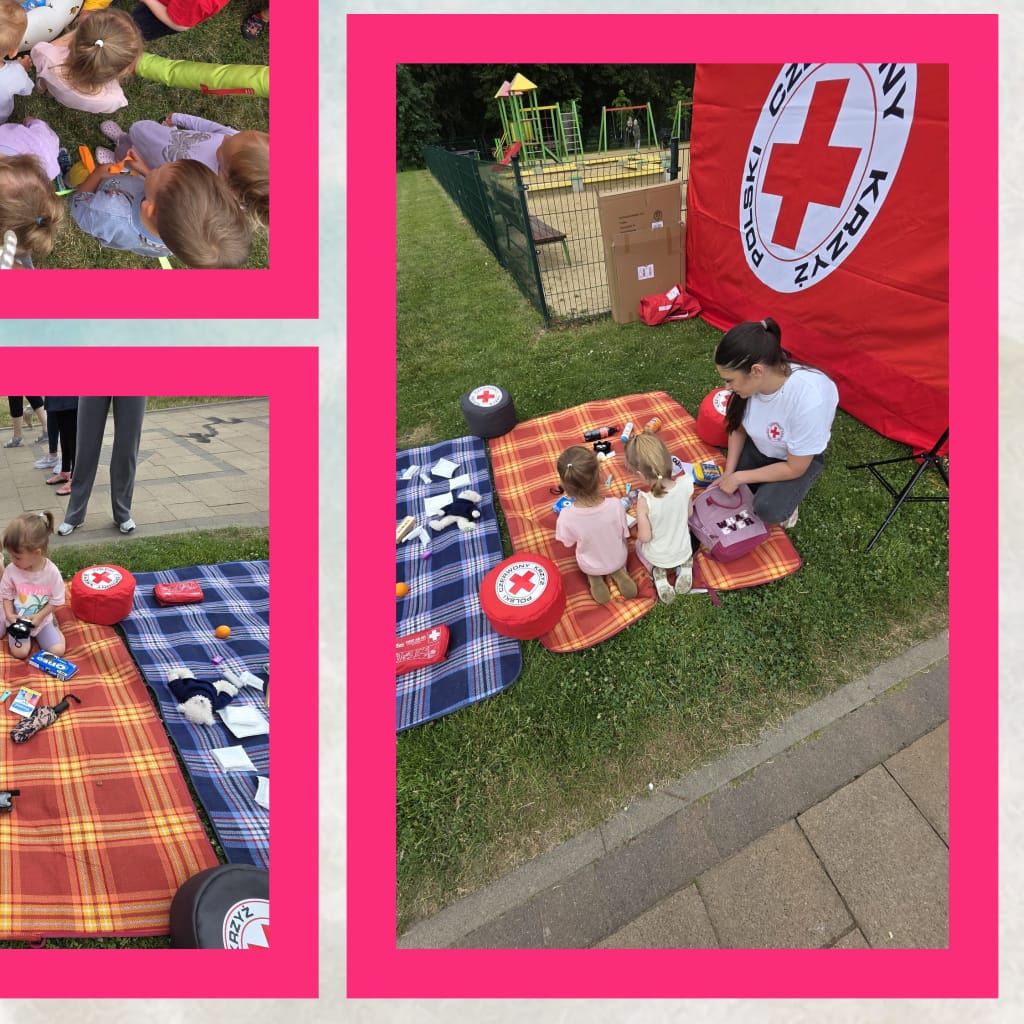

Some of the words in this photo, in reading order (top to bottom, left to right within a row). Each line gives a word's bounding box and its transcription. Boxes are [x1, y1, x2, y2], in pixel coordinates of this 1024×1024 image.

[743, 145, 764, 268] POLSKI
[794, 169, 889, 288] KRZYŻ
[716, 509, 750, 529] WHAT
[498, 563, 531, 593] CZERWONY
[503, 594, 533, 604] POLSKI
[37, 656, 67, 671] OREO
